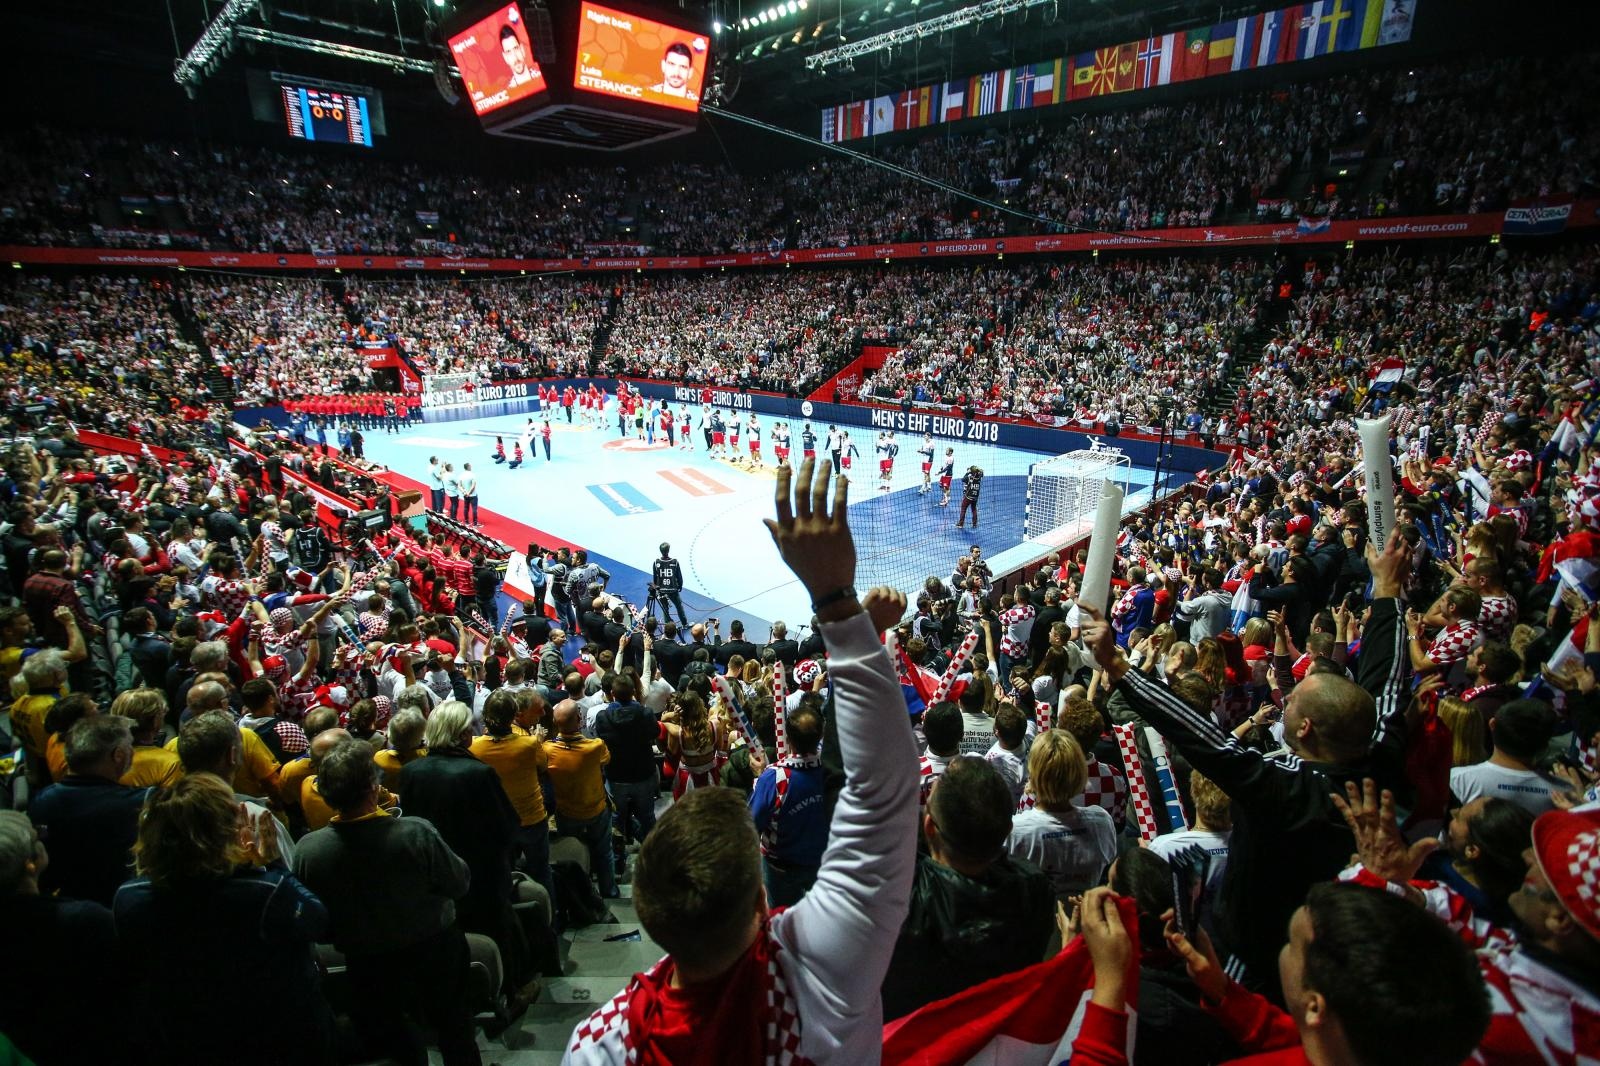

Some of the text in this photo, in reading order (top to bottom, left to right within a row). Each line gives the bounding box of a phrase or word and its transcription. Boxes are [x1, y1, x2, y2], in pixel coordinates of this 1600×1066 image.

[587, 10, 632, 31] Right back
[582, 53, 590, 63] 7
[581, 65, 602, 76] Luka
[579, 75, 643, 97] STEPANCIC
[1359, 221, 1468, 235] www.ehf-euro.com
[969, 243, 987, 251] 2018
[316, 257, 338, 266] SPLIT
[504, 383, 528, 398] 2018
[675, 387, 696, 402] MEN'S
[712, 390, 732, 406] EURO
[733, 393, 752, 409] 2018
[871, 409, 999, 442] MEN'S EHF EURO 2018
[659, 568, 673, 577] HB
